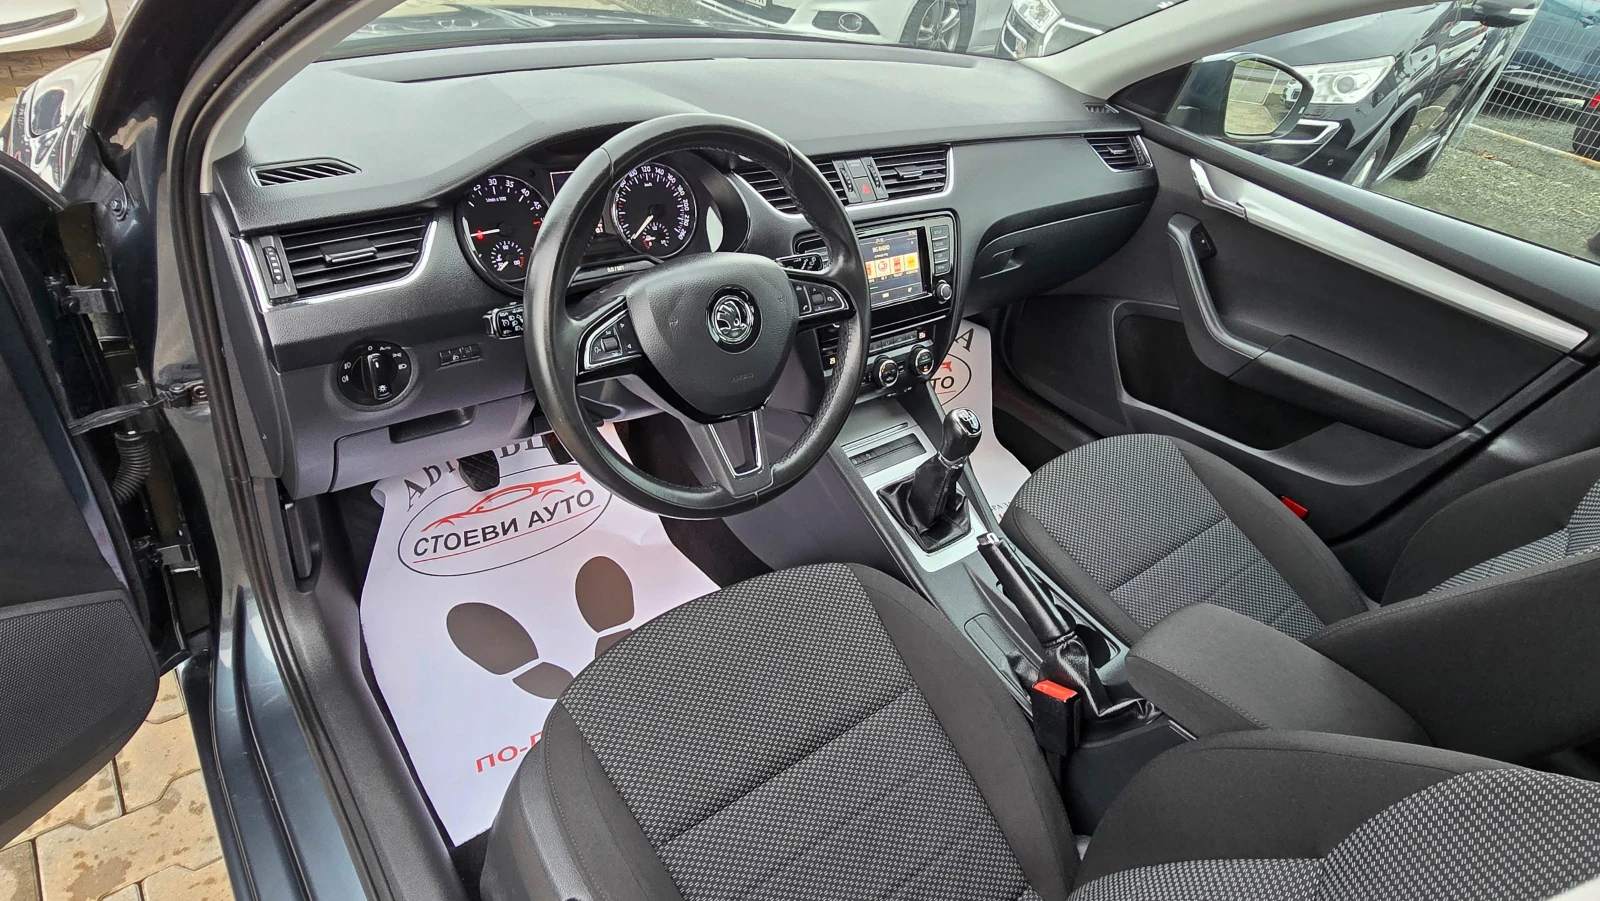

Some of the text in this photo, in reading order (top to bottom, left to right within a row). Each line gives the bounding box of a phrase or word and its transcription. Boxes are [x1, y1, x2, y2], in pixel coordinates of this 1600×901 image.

[641, 165, 651, 173] 120
[655, 167, 664, 175] 140
[488, 178, 497, 186] 30
[505, 179, 514, 188] 35
[520, 187, 530, 197] 40
[533, 201, 542, 210] 45
[682, 198, 690, 211] 200
[413, 489, 595, 557] СТОЕВИ АУТО
